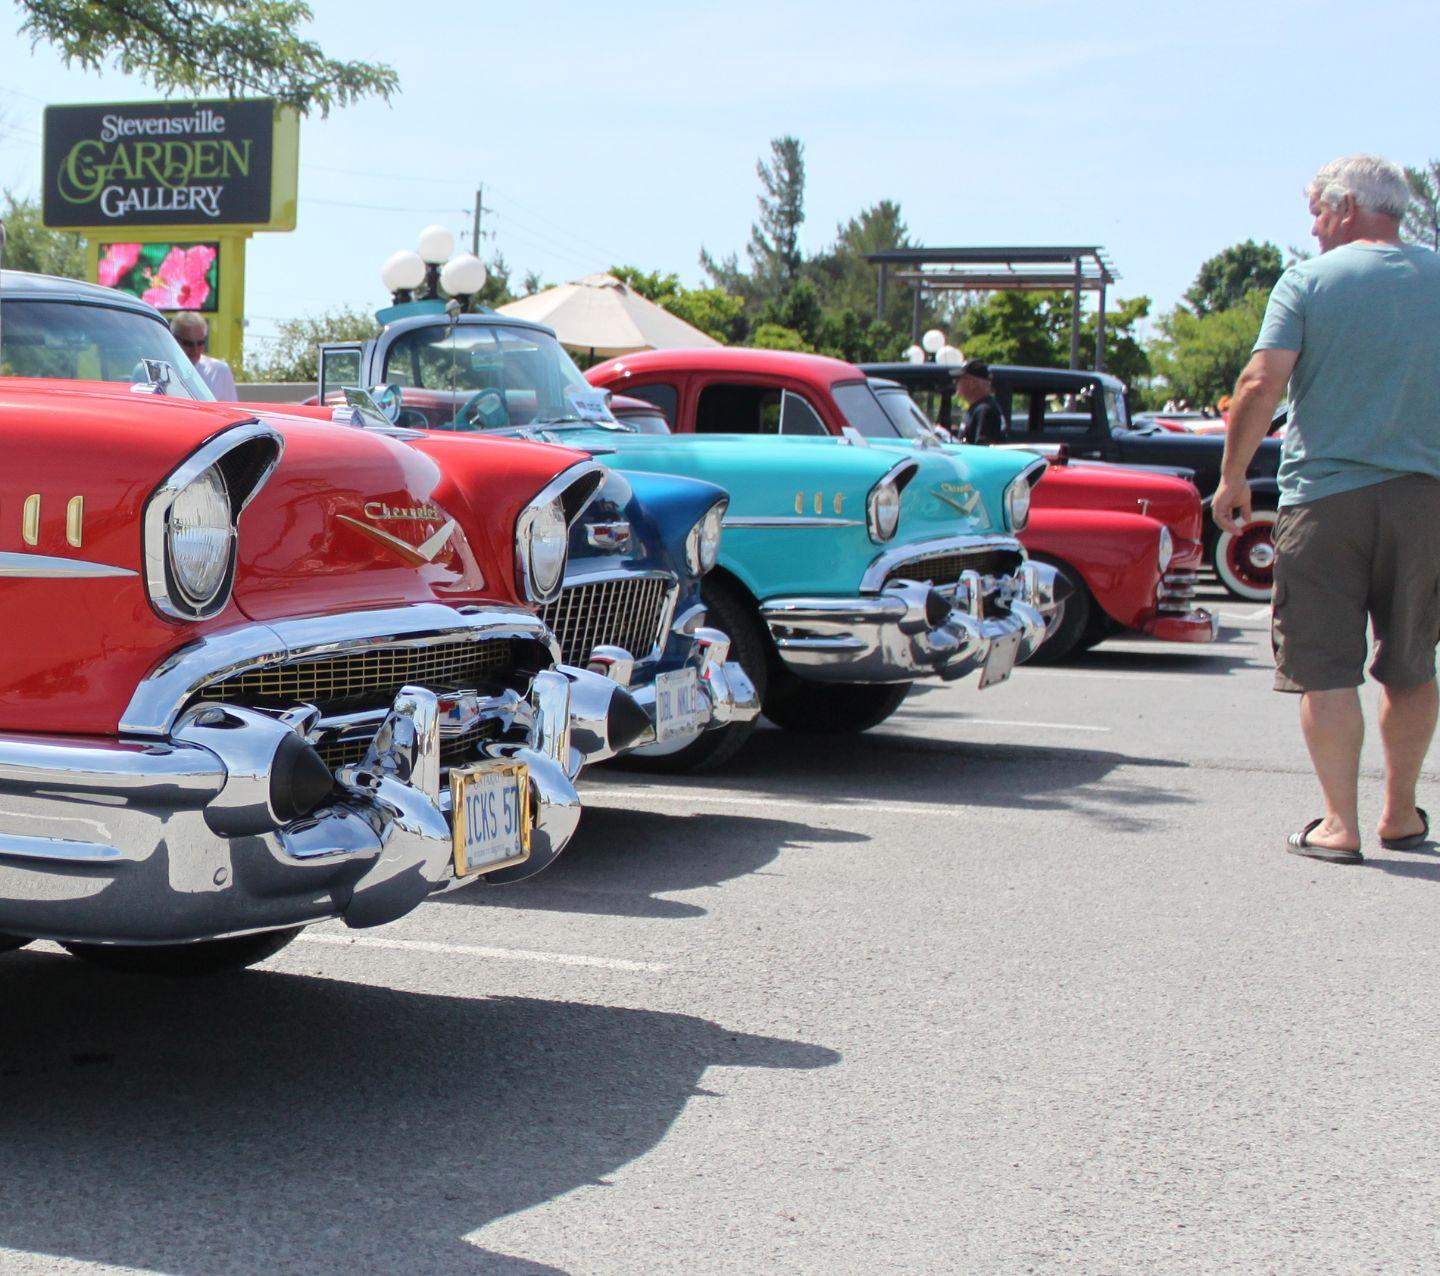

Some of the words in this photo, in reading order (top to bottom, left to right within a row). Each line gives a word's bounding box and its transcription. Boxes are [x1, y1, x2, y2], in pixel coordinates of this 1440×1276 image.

[101, 110, 226, 142] Stevensville
[57, 139, 253, 204] GARDEN
[100, 185, 223, 217] GALLERY
[363, 501, 443, 521] Chevrolet
[466, 791, 497, 845] ICKS
[503, 786, 519, 834] 57
